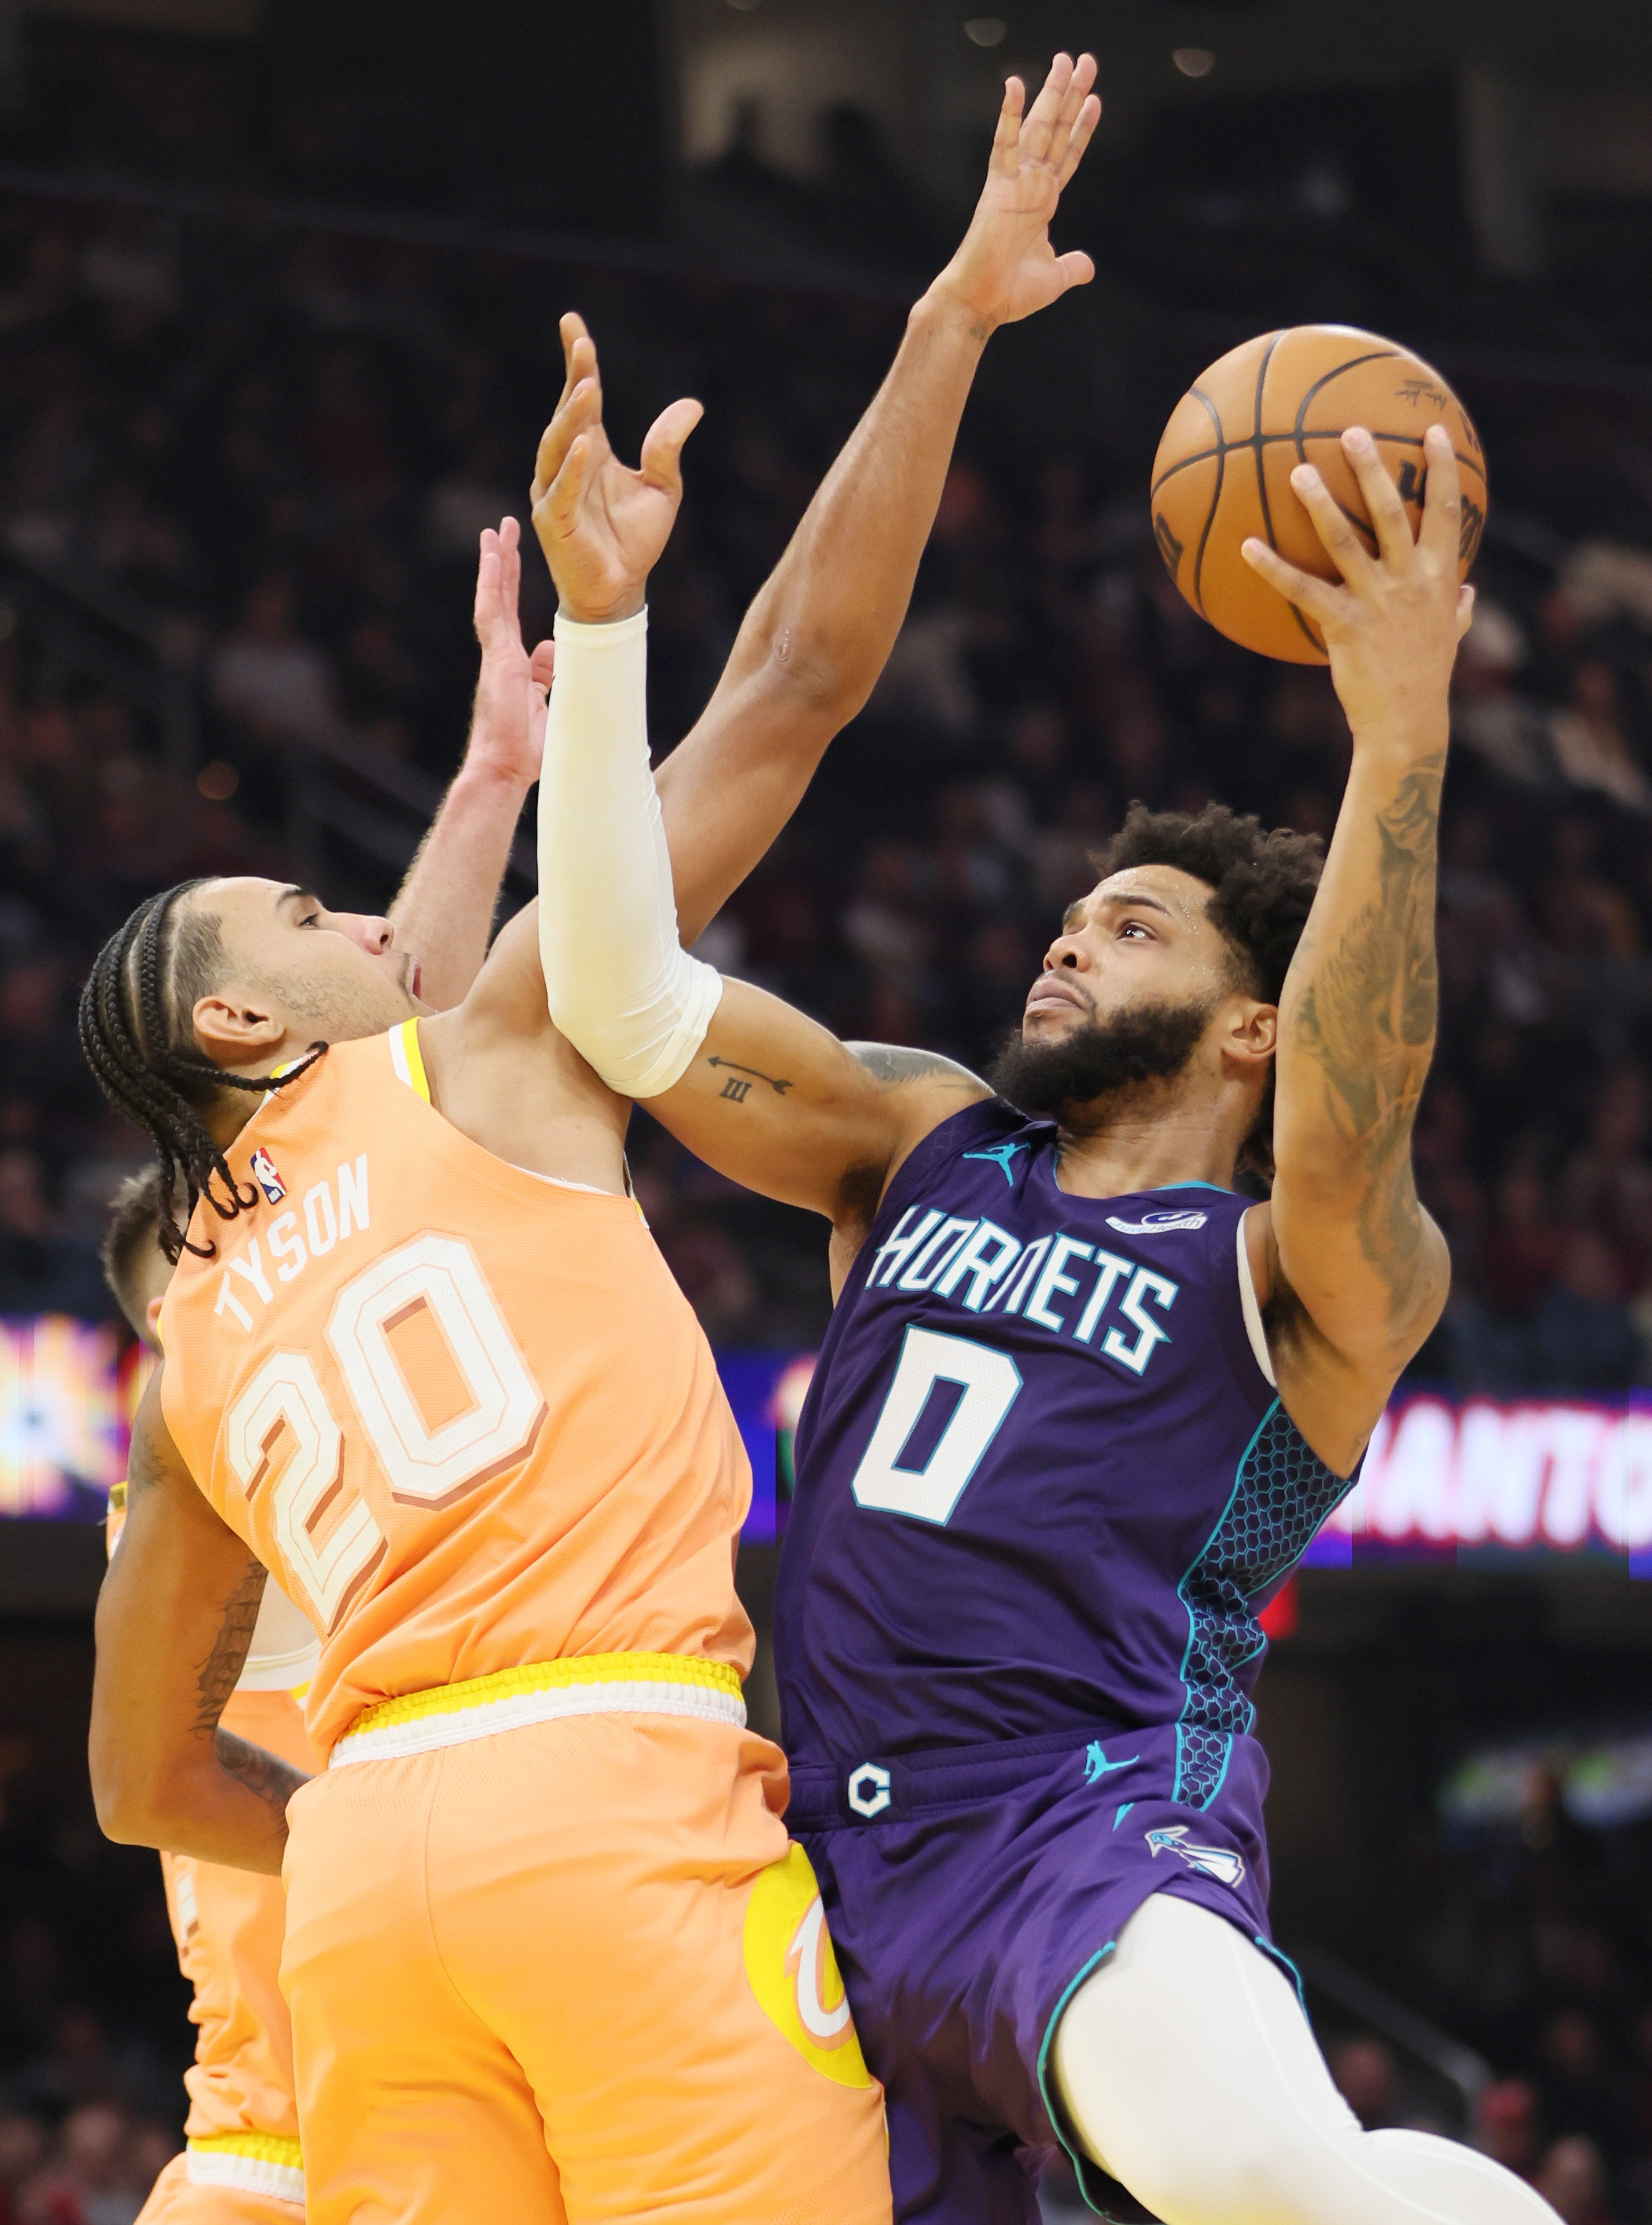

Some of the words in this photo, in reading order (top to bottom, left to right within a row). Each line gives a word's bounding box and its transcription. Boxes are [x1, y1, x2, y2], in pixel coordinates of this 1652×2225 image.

[213, 1153, 370, 1332] TYSON
[268, 1188, 281, 1204] NBA
[865, 1204, 1179, 1376] HORNETS
[226, 1228, 548, 1638] 20
[850, 1323, 1024, 1527] 0
[1321, 1399, 1652, 1549] ANTO
